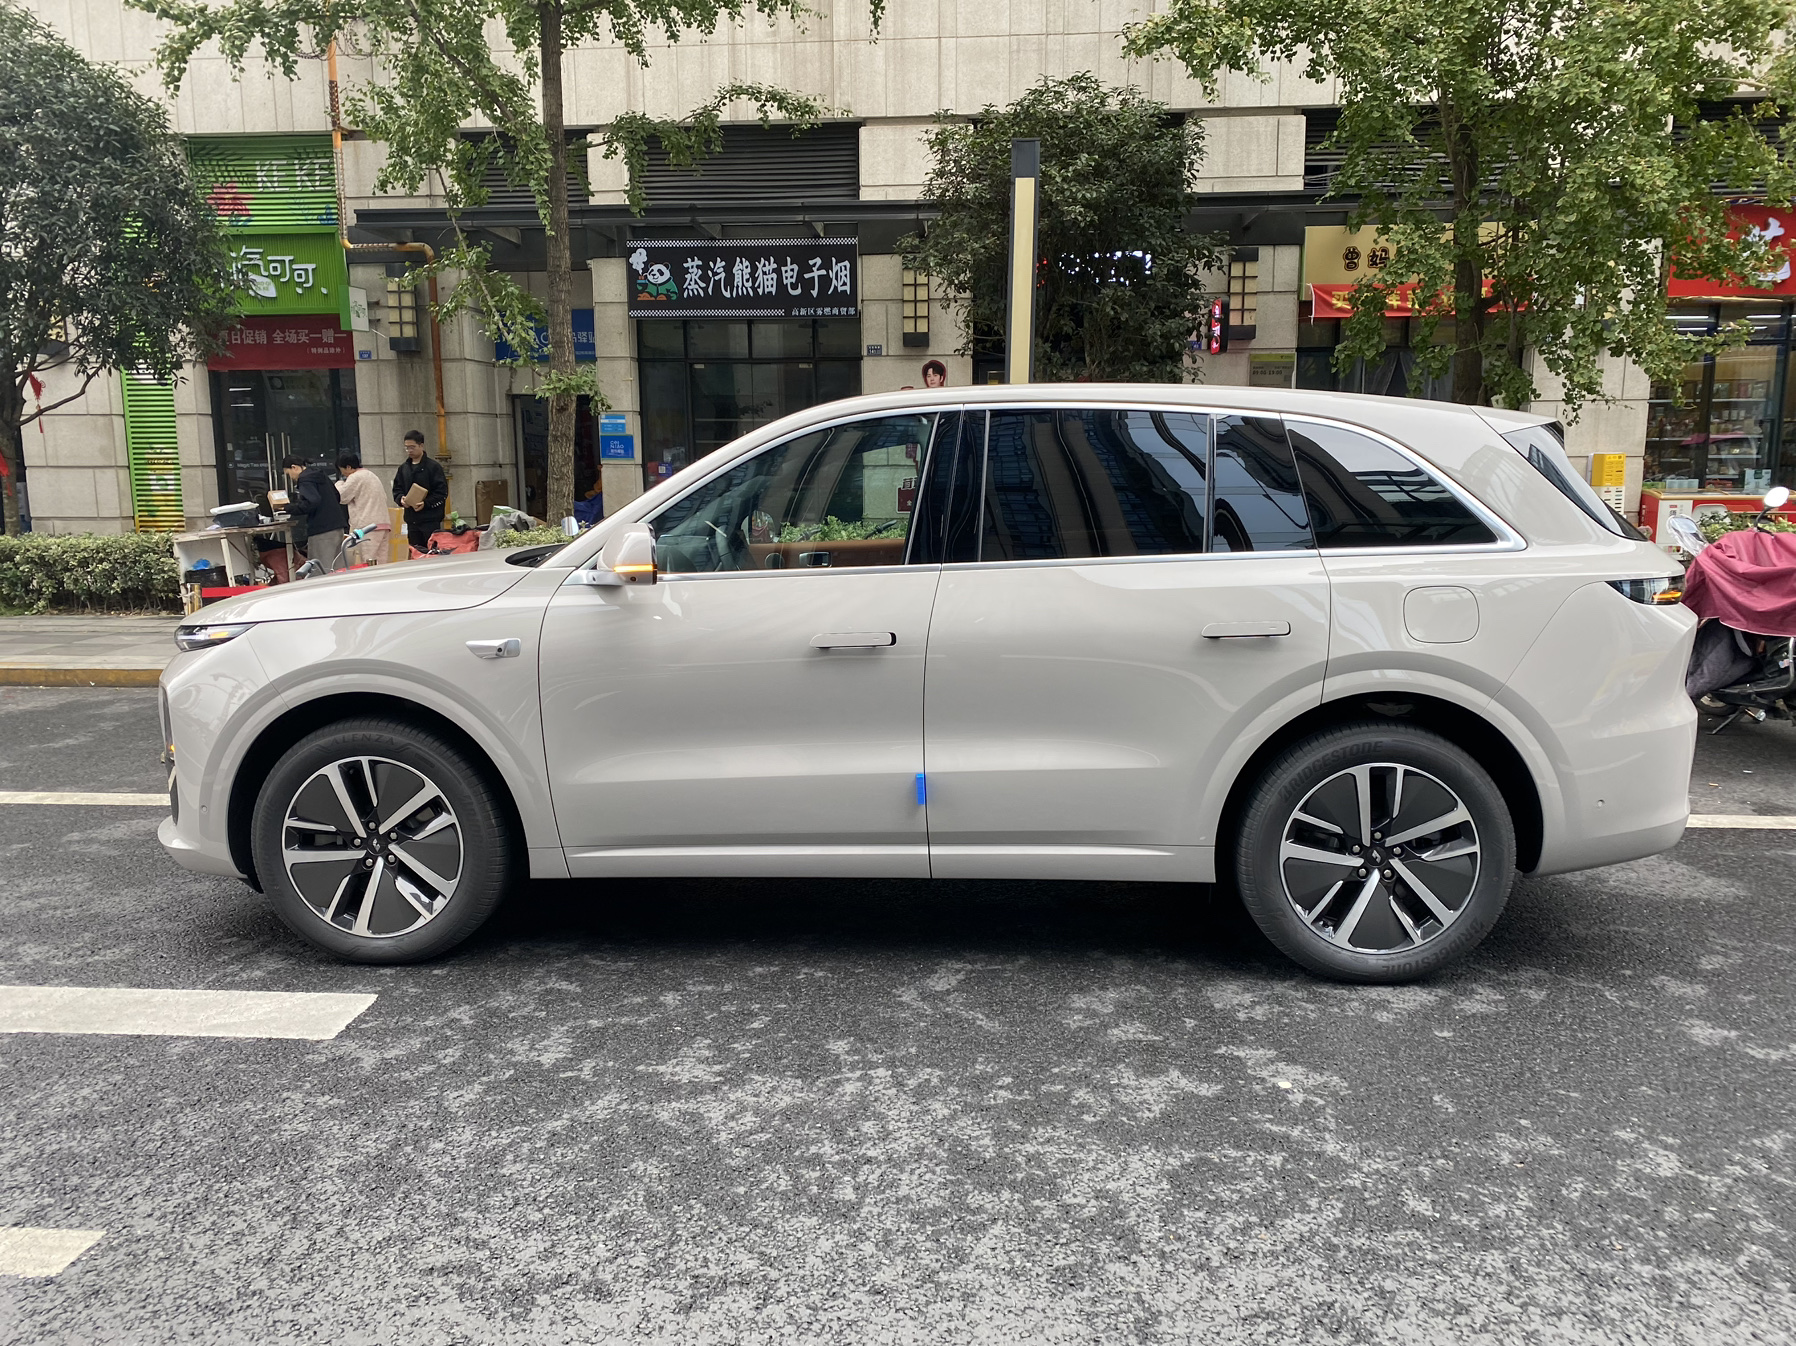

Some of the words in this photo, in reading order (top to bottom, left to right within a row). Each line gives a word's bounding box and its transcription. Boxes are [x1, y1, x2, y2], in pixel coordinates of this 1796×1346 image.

[683, 256, 851, 298] 蒸汽熊猫电子烟
[272, 328, 347, 344] 全场买一赠一
[331, 733, 395, 746] ALENZA
[1277, 740, 1384, 803] BRIDGESTONE
[1381, 916, 1482, 978] BRIDGESTONE
